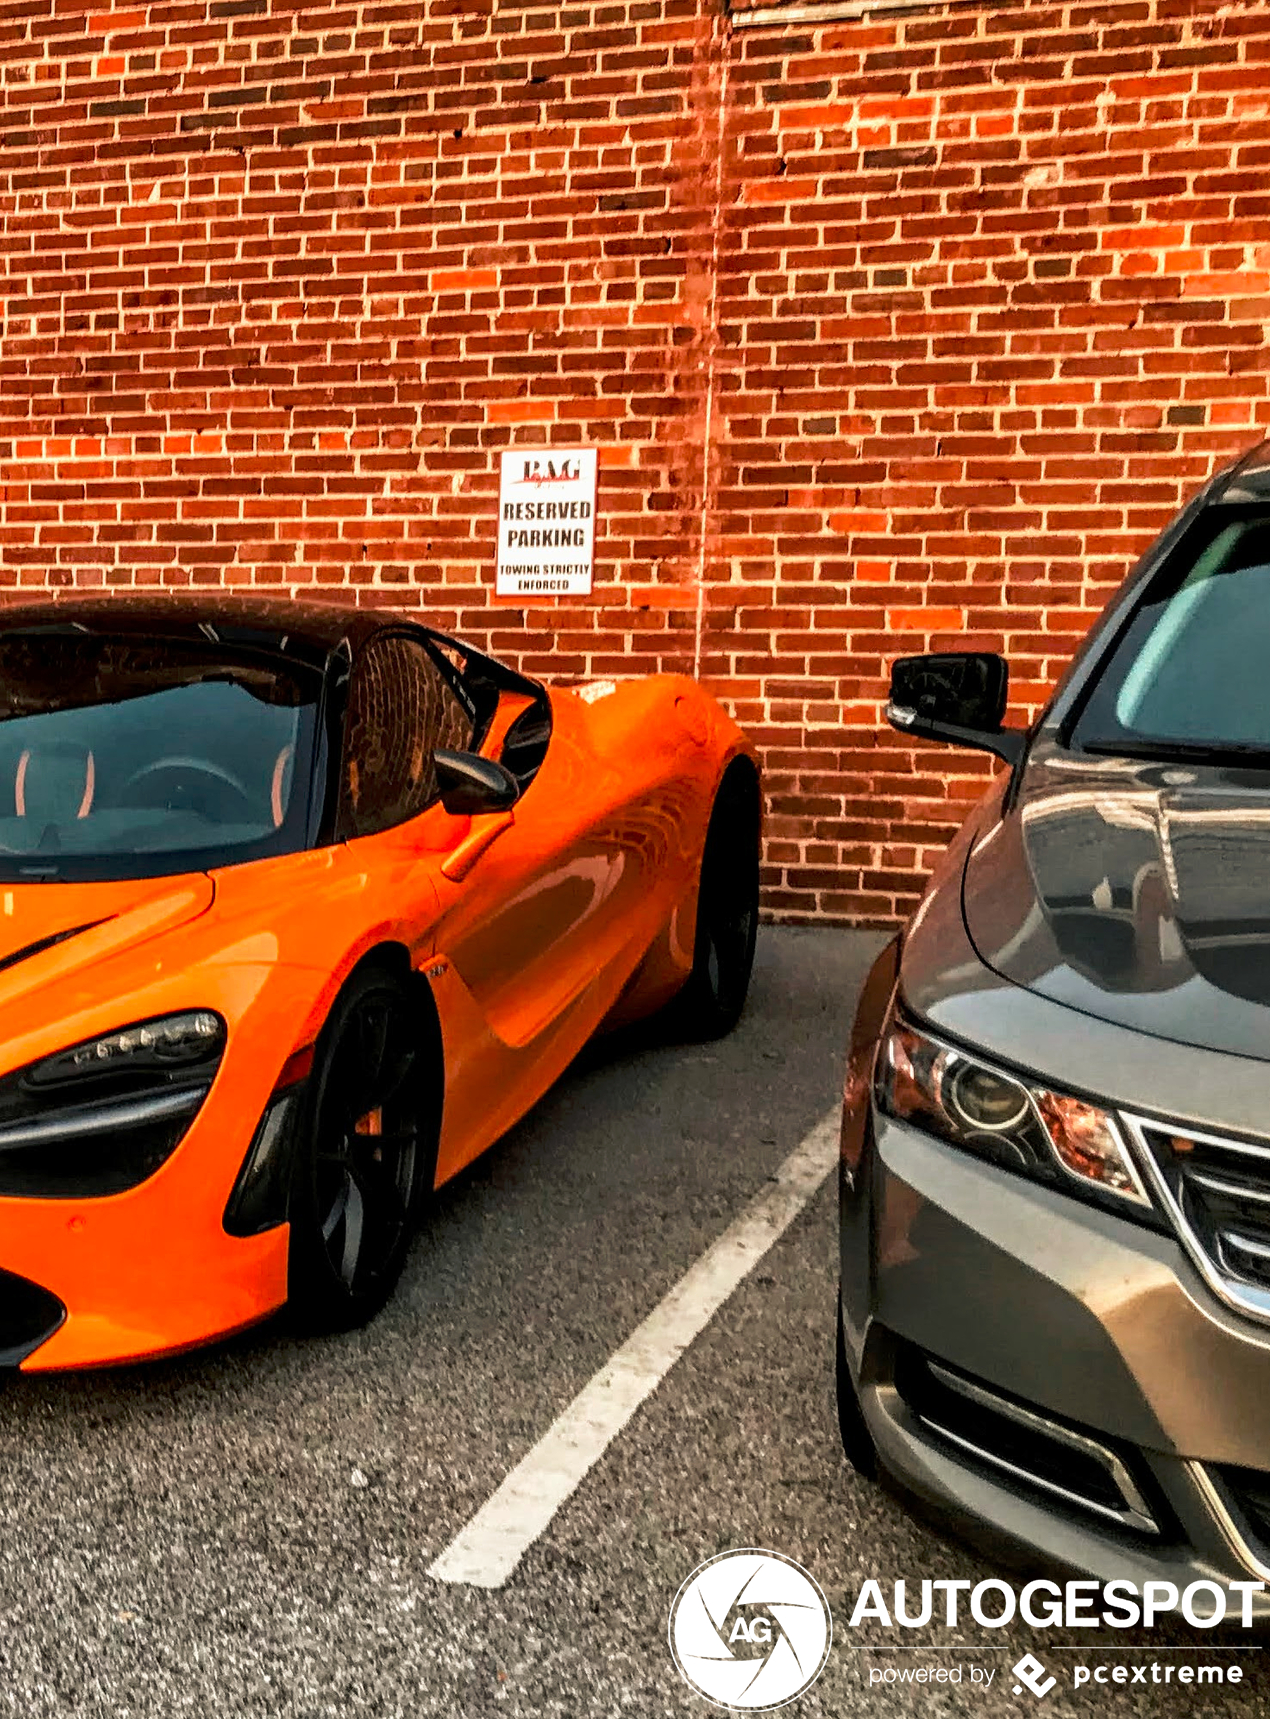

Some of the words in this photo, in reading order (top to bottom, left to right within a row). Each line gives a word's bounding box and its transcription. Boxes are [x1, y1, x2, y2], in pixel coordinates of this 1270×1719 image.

[503, 501, 591, 520] RESERVED
[507, 528, 585, 548] PARKING
[500, 565, 540, 575] TOWING
[543, 564, 590, 575] STRICTLY
[518, 580, 570, 590] ENFORCED
